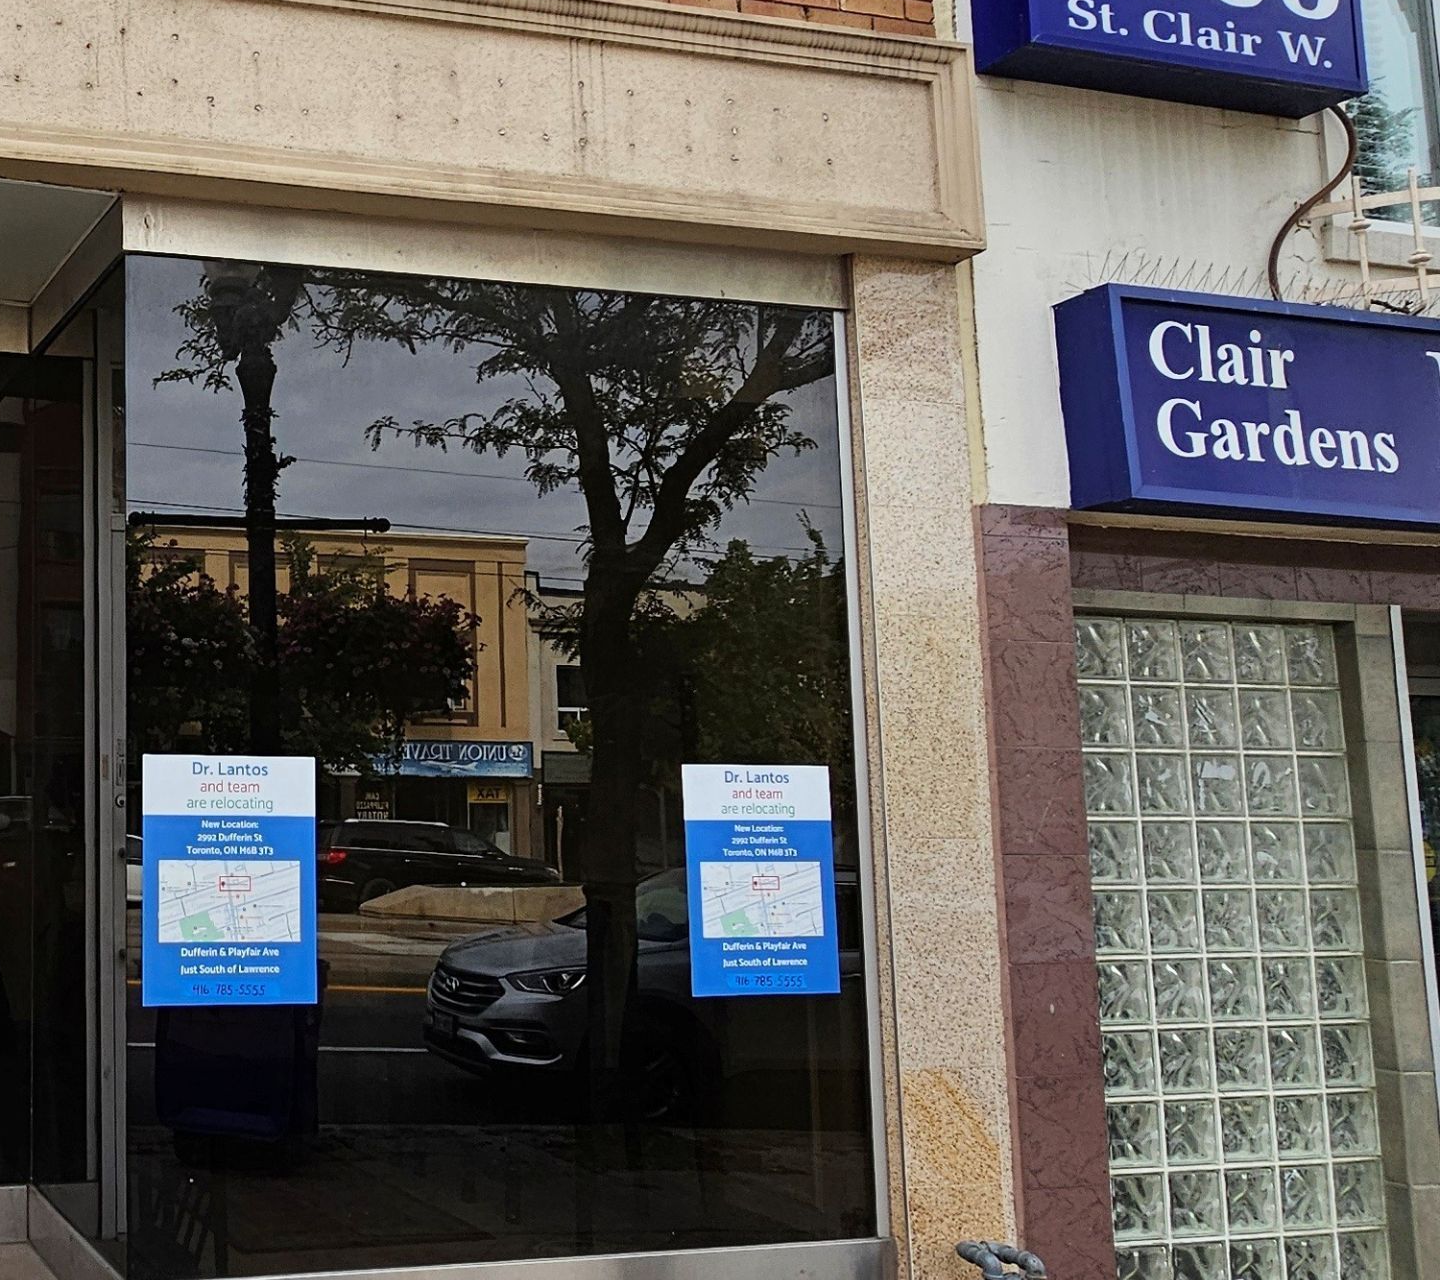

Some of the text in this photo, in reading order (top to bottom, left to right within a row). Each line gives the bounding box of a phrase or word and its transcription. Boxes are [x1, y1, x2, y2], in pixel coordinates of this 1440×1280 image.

[1143, 9, 1262, 57] Clair
[1277, 30, 1333, 69] W.
[1148, 320, 1295, 389] Clair
[1156, 397, 1400, 474] Gardens
[192, 761, 269, 776] Dr. Lantos
[724, 770, 790, 784] Dr. Lantos
[200, 780, 261, 793] and team
[732, 788, 783, 800] and team
[186, 796, 274, 813] are relocating
[721, 803, 796, 818] are relocating
[201, 820, 259, 829] New Location:
[734, 825, 751, 833] New
[197, 833, 263, 843] 2992 Dufferin St
[749, 836, 779, 845] Dufferin
[186, 845, 222, 856] Toronto,
[224, 846, 238, 855] ON
[755, 848, 767, 857] ON
[722, 942, 754, 951] Dufferin
[762, 942, 791, 951] Playfair
[792, 942, 807, 950] Ave
[181, 947, 280, 959] Dufferin & Playfair Ave
[722, 958, 808, 968] Just South of Lawrence
[180, 964, 280, 976] Just South of Lawrence
